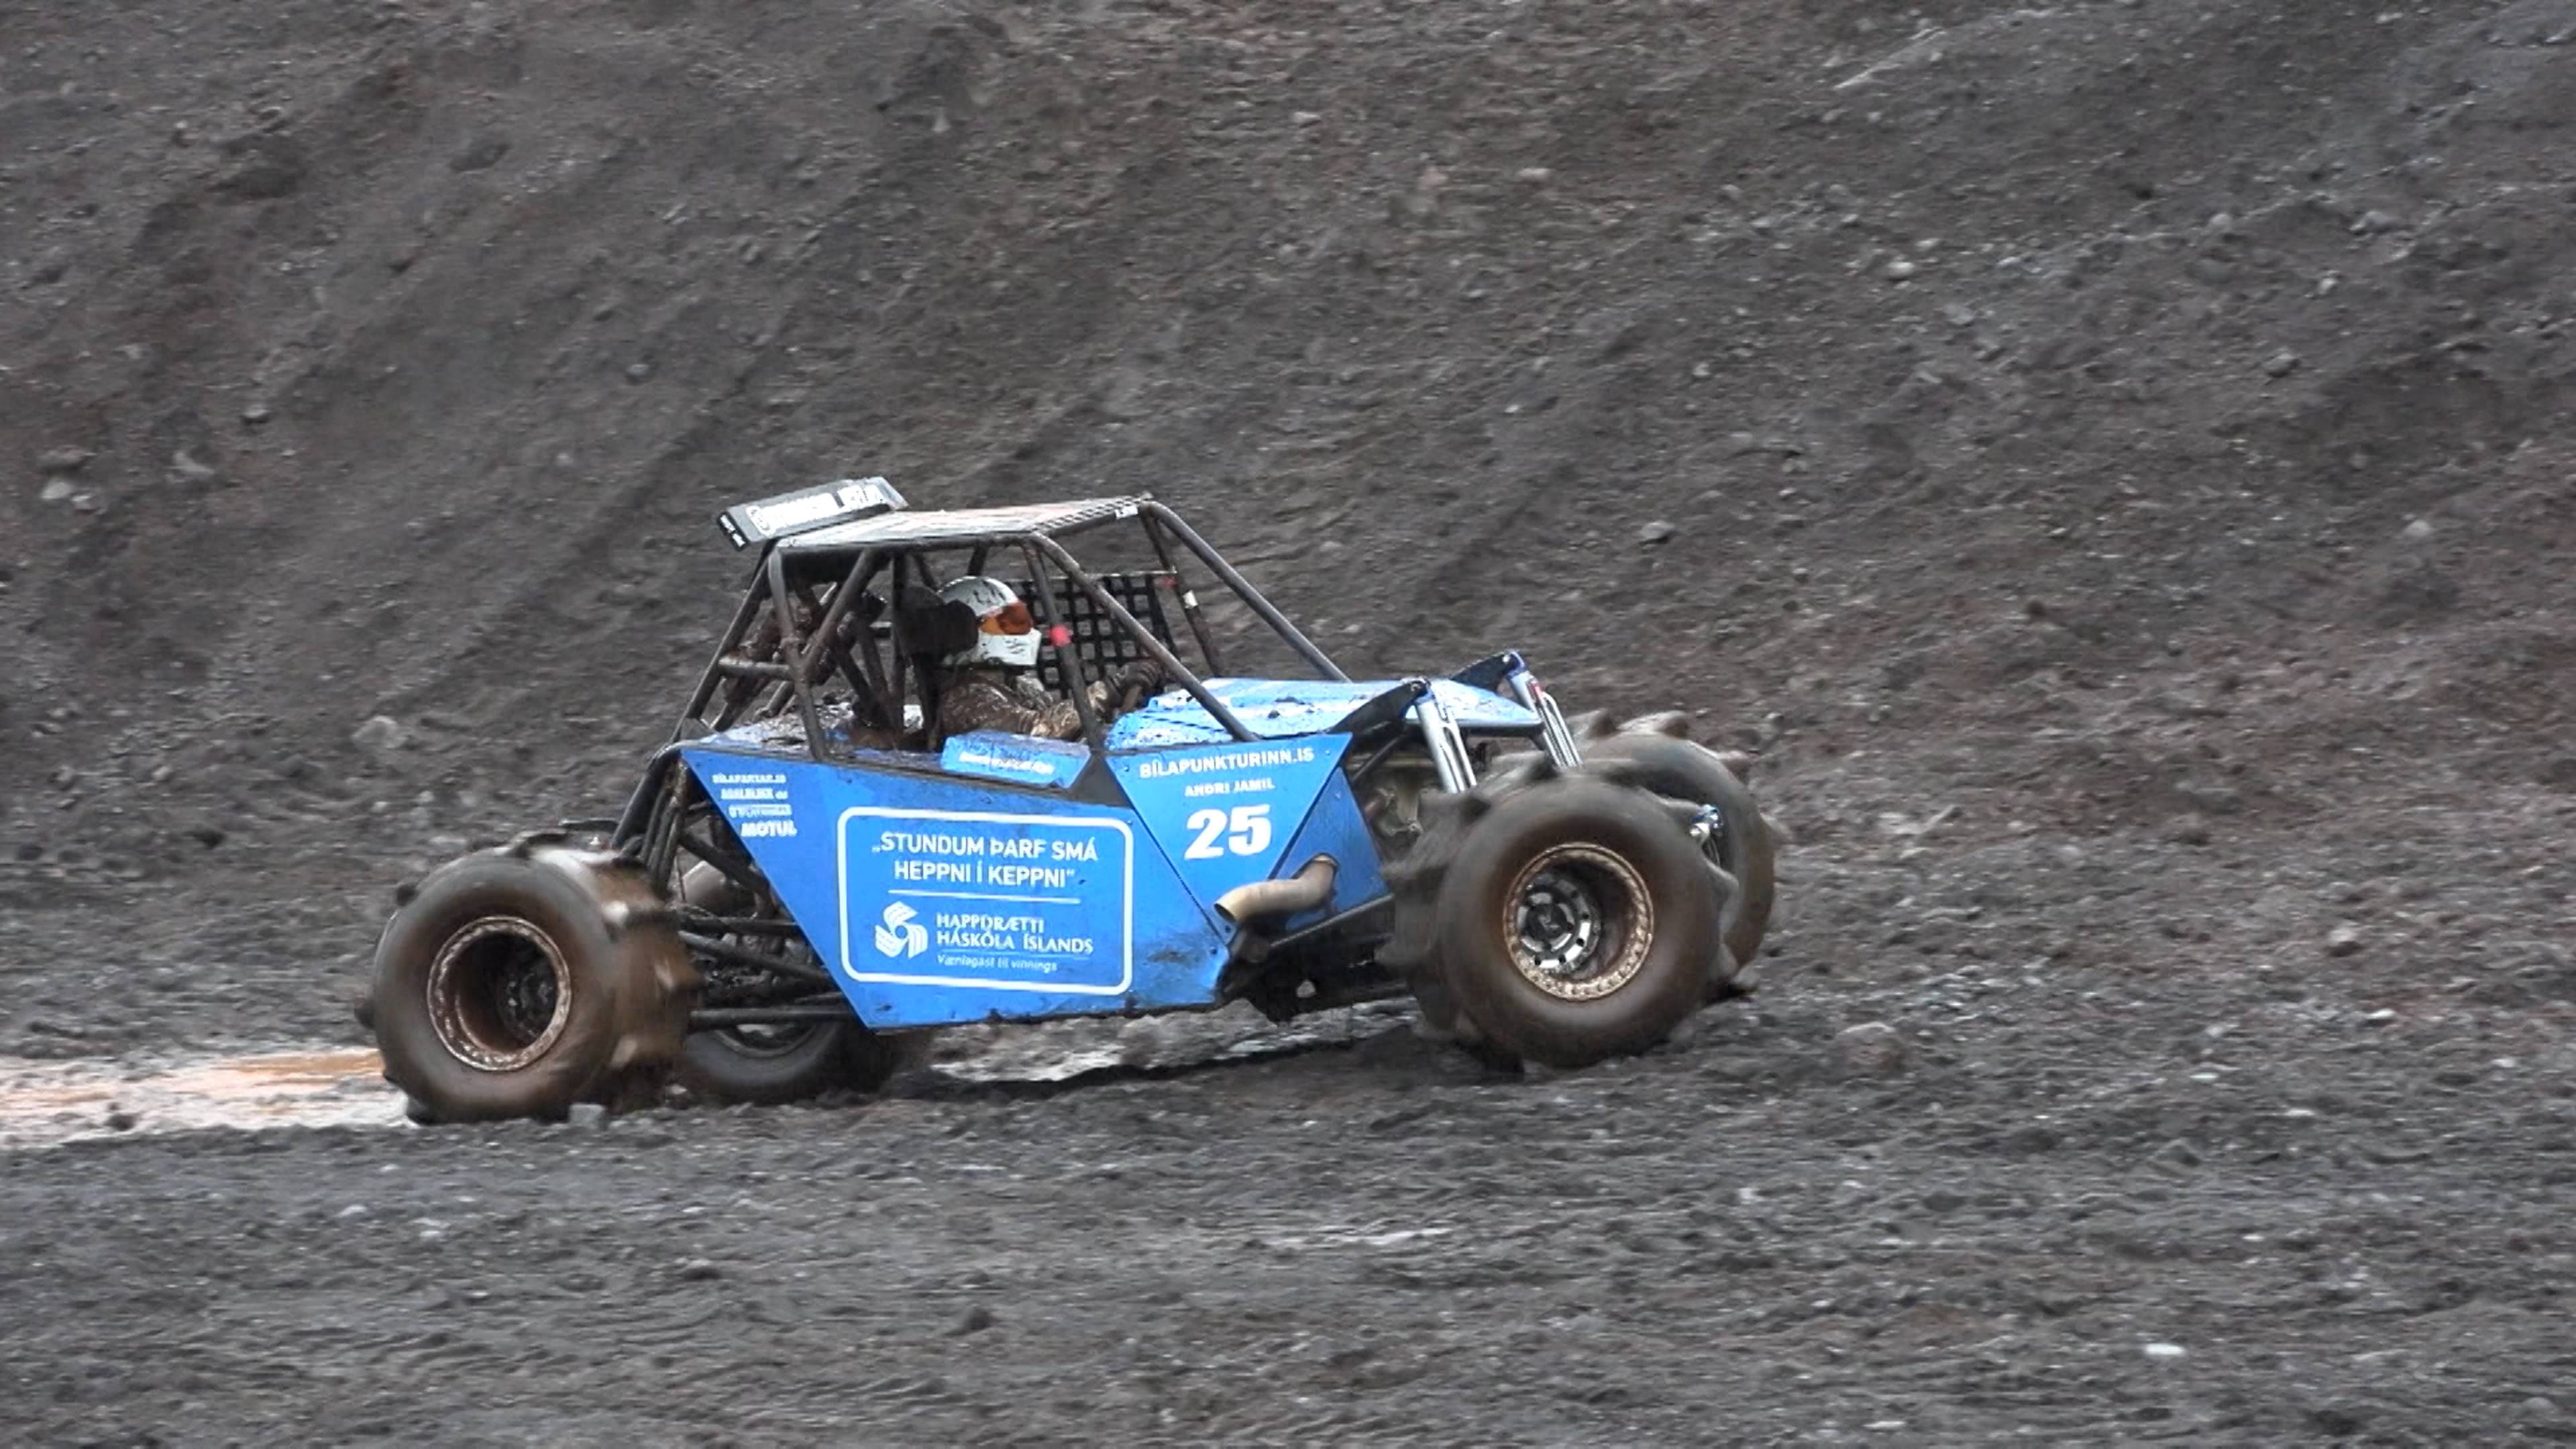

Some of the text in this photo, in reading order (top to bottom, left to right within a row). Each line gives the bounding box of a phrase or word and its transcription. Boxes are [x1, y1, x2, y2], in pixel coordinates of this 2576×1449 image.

[1140, 747, 1314, 778] BÍLAPUNKTURINN.IS
[1185, 777, 1275, 796] ANDRI JAMIL
[741, 820, 797, 837] MOTUL
[1184, 804, 1271, 860] 25
[990, 837, 1046, 859] ÞARF
[1052, 837, 1098, 861] SMÁ
[894, 861, 971, 883] HEPPNI
[977, 859, 983, 883] Í
[936, 912, 1044, 934] HAPPDRÆTTI
[937, 926, 1094, 955] HÁSKÓLA ÍSLANDS
[998, 957, 1009, 969] til
[1012, 960, 1058, 974] vinnings
